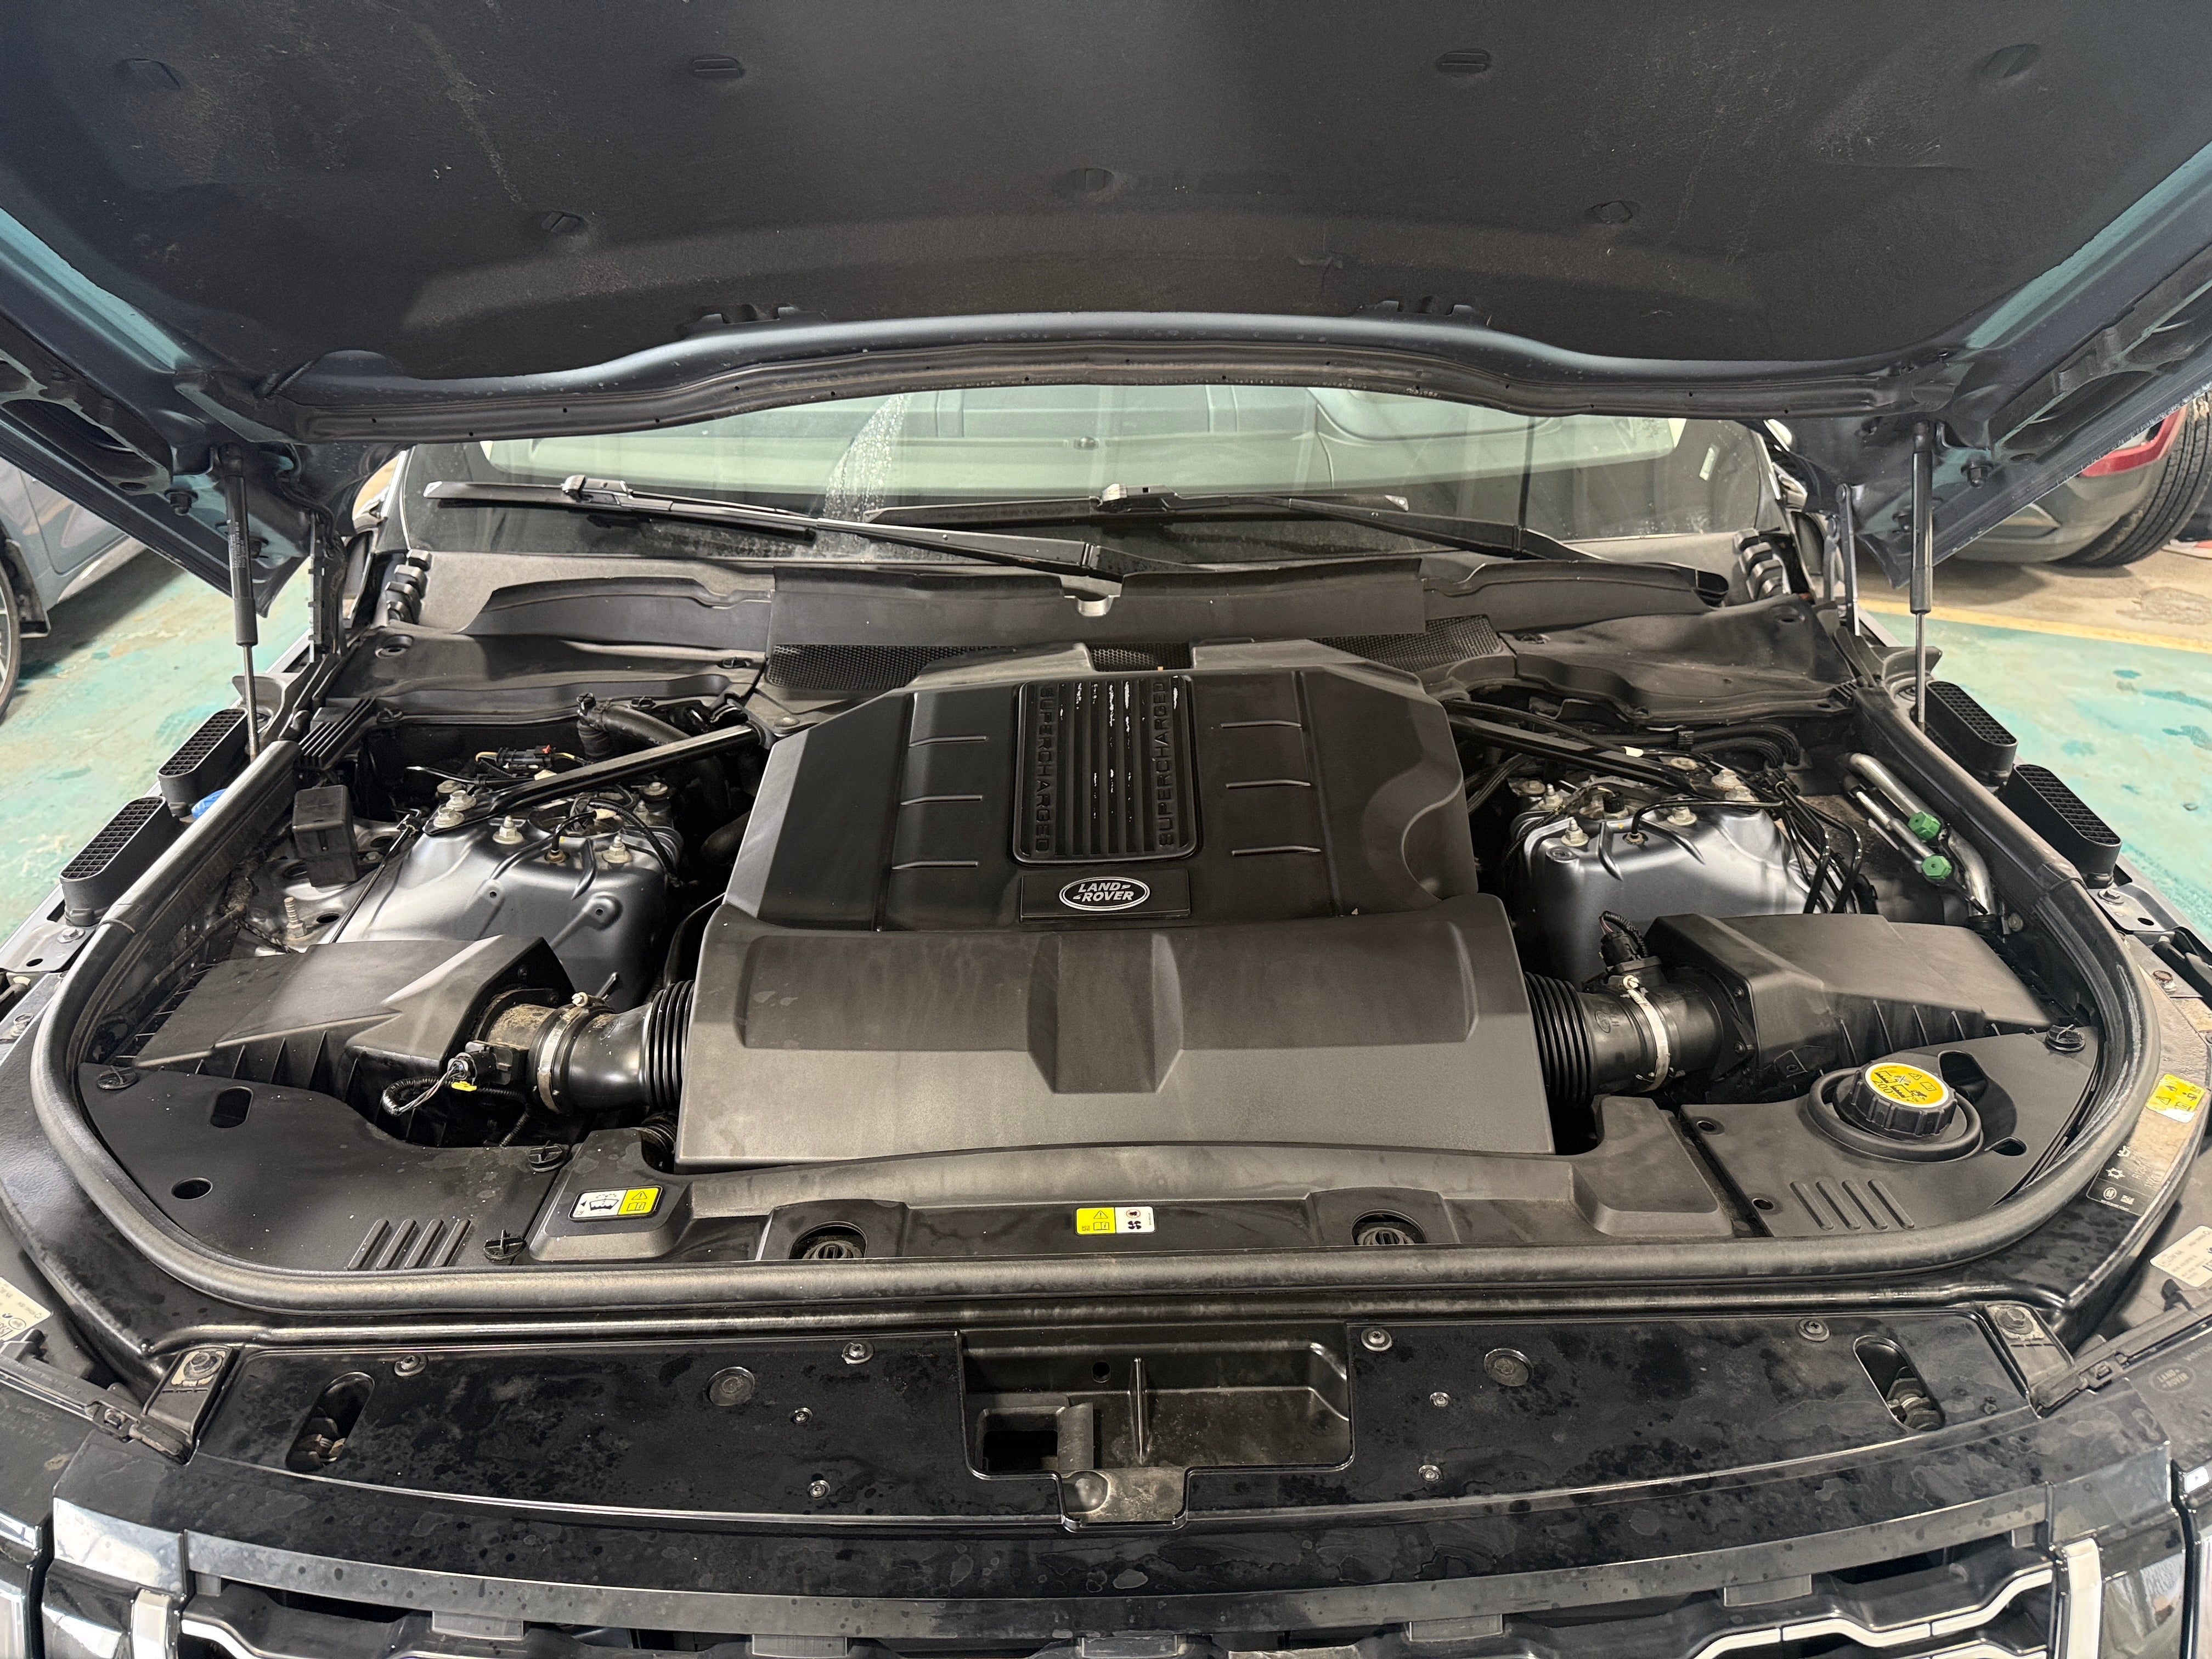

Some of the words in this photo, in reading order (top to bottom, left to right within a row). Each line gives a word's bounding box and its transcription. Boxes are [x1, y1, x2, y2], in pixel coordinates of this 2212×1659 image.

[1035, 687, 1054, 852] SUPERCHARGED
[1153, 682, 1173, 847] SUPERCHARGED
[1078, 882, 1121, 893] LAND
[1081, 891, 1135, 902] ROVER
[1871, 1079, 1893, 1093] 200
